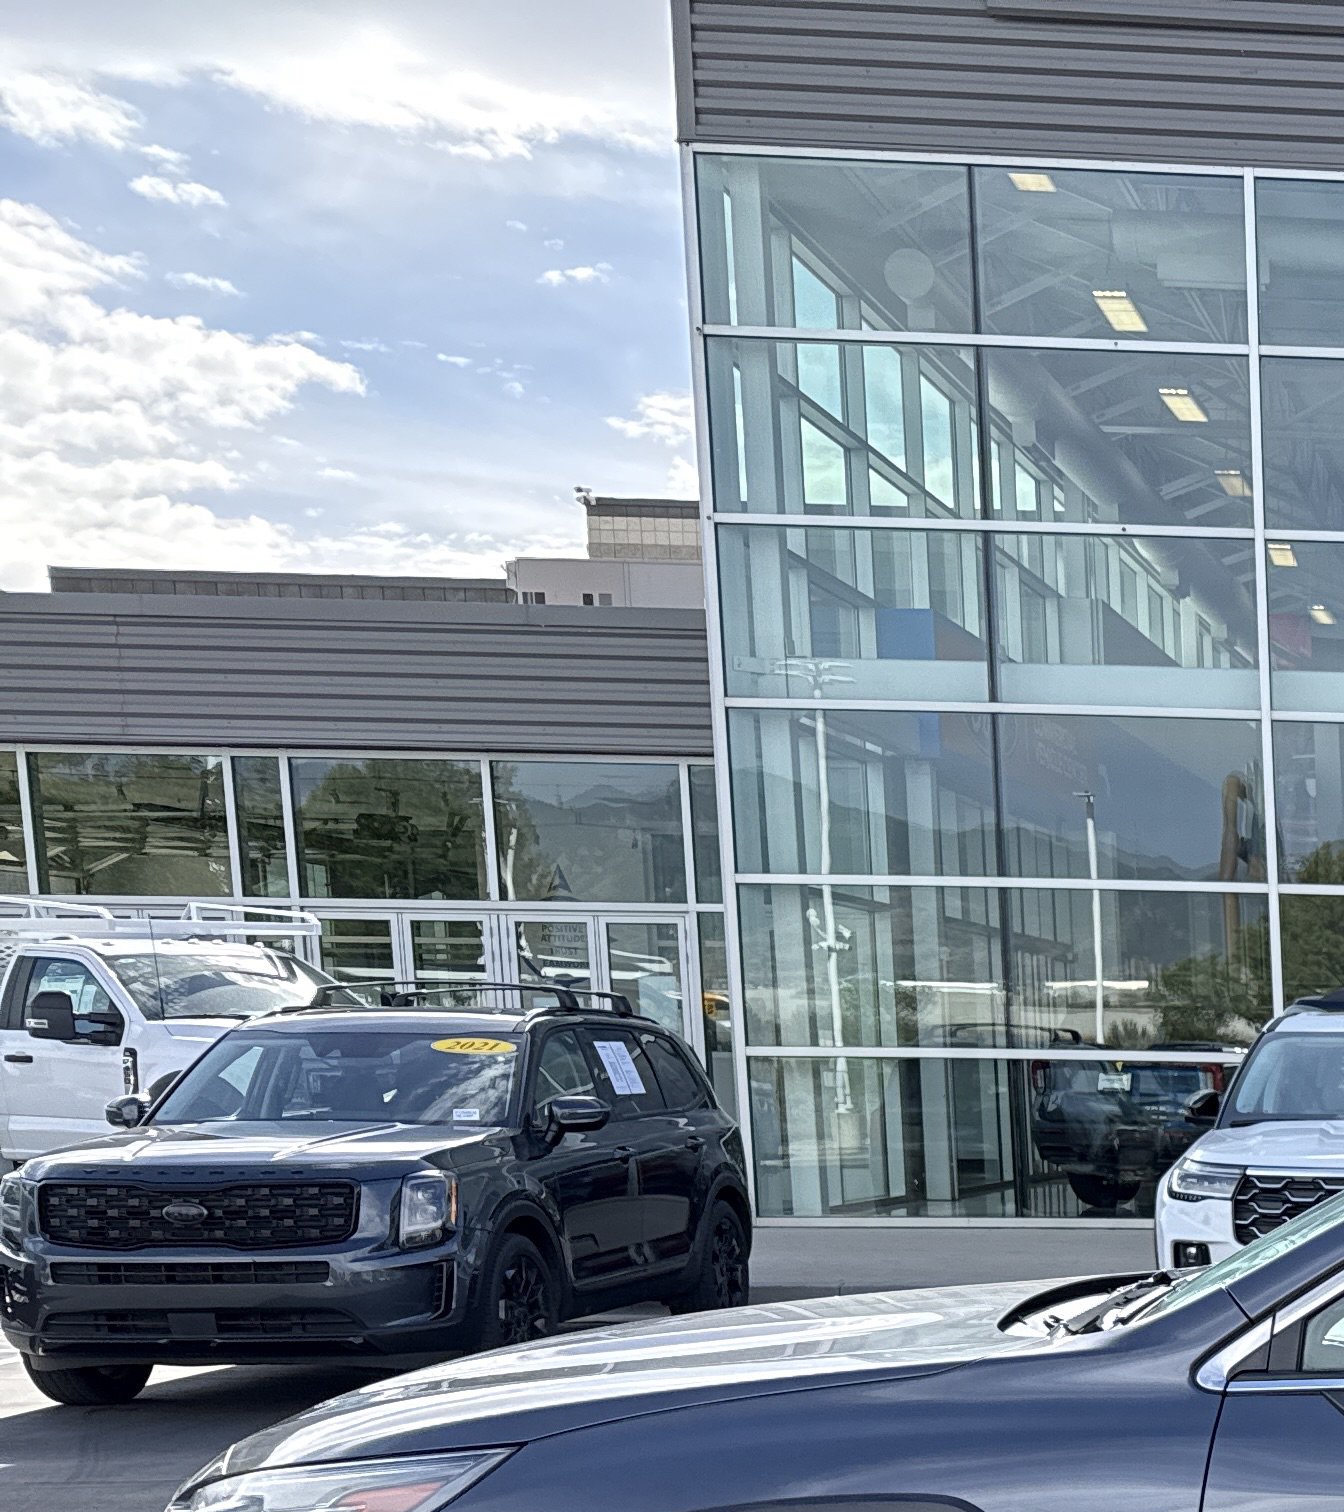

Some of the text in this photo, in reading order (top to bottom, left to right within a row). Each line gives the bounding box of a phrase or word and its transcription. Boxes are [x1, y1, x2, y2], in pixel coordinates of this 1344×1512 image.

[541, 923, 586, 933] POSITIVE
[540, 934, 587, 943] ATTITUDE
[445, 1040, 501, 1051] 2021
